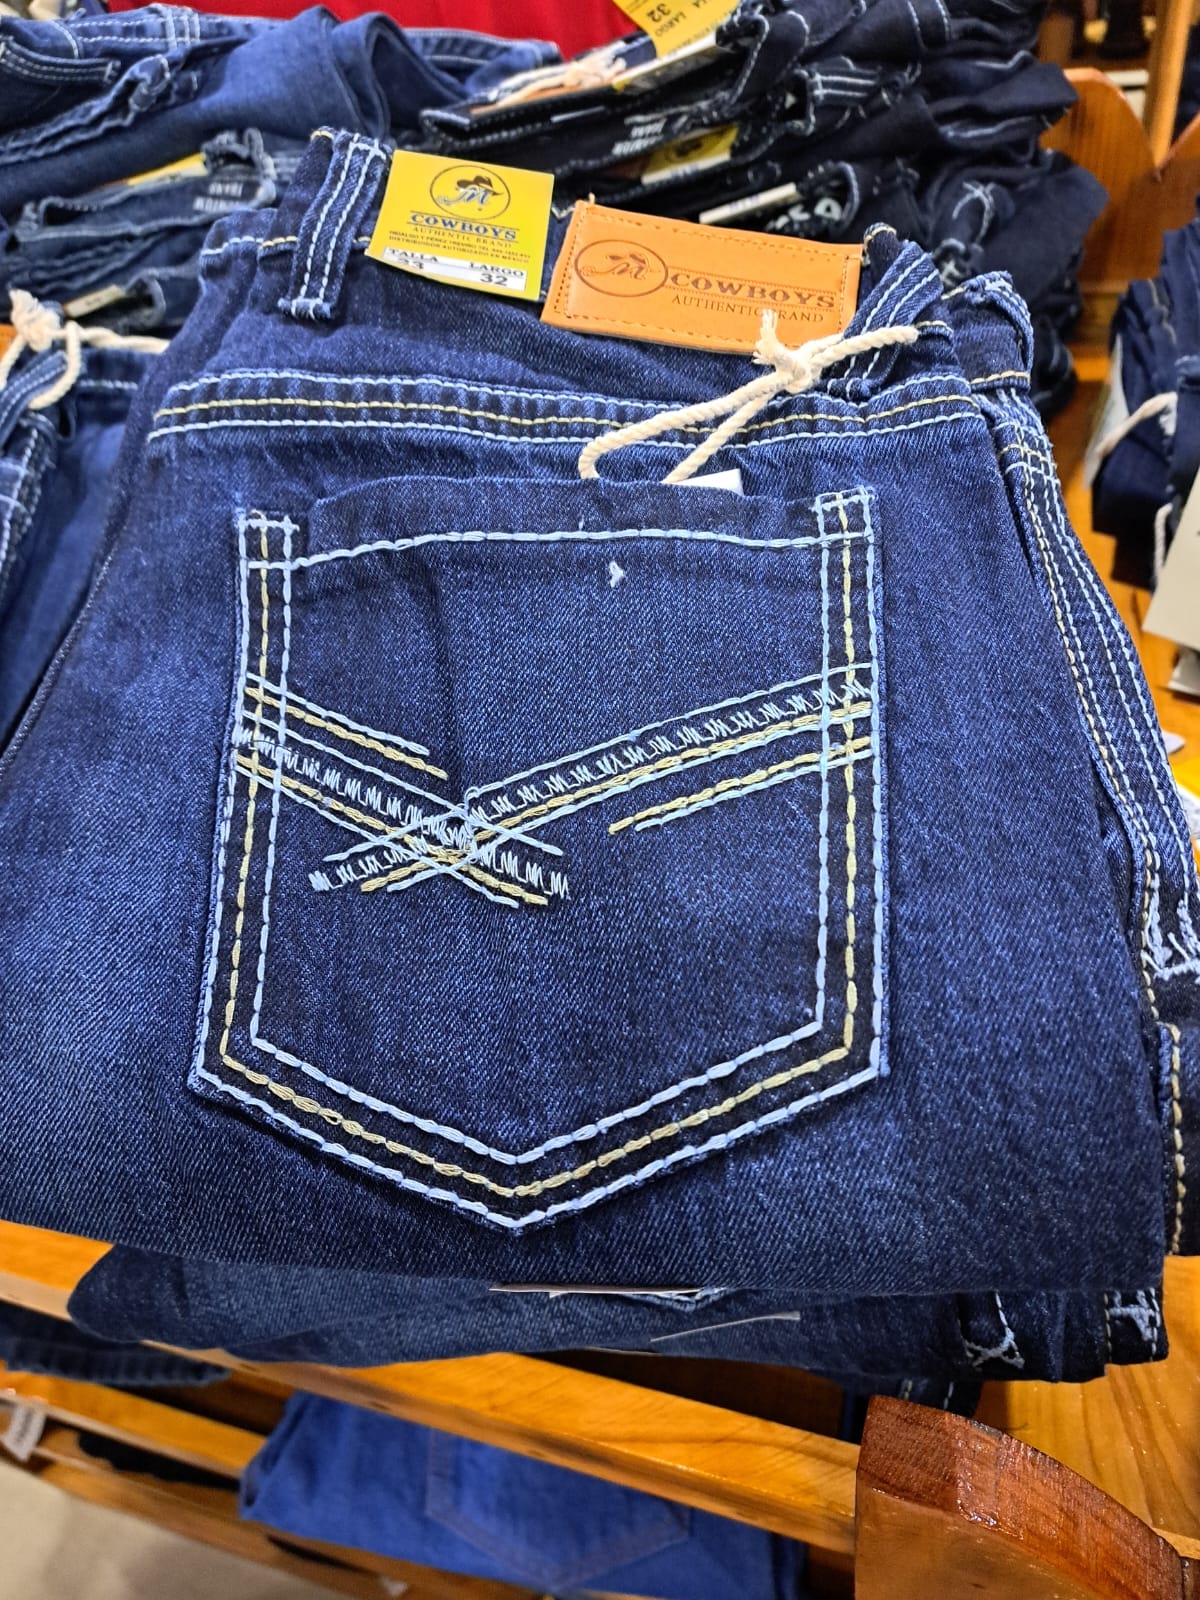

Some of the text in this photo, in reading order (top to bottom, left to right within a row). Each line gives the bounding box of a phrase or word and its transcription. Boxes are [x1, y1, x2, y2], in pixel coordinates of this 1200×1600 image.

[647, 3, 671, 22] 32
[655, 11, 687, 37] LARGO
[411, 213, 516, 240] COWBOYS
[413, 227, 512, 249] AUTHENTIC BRAND
[390, 249, 438, 263] TALLA
[470, 262, 524, 277] LARGO
[480, 273, 508, 286] 32
[670, 272, 835, 309] COWBOYS
